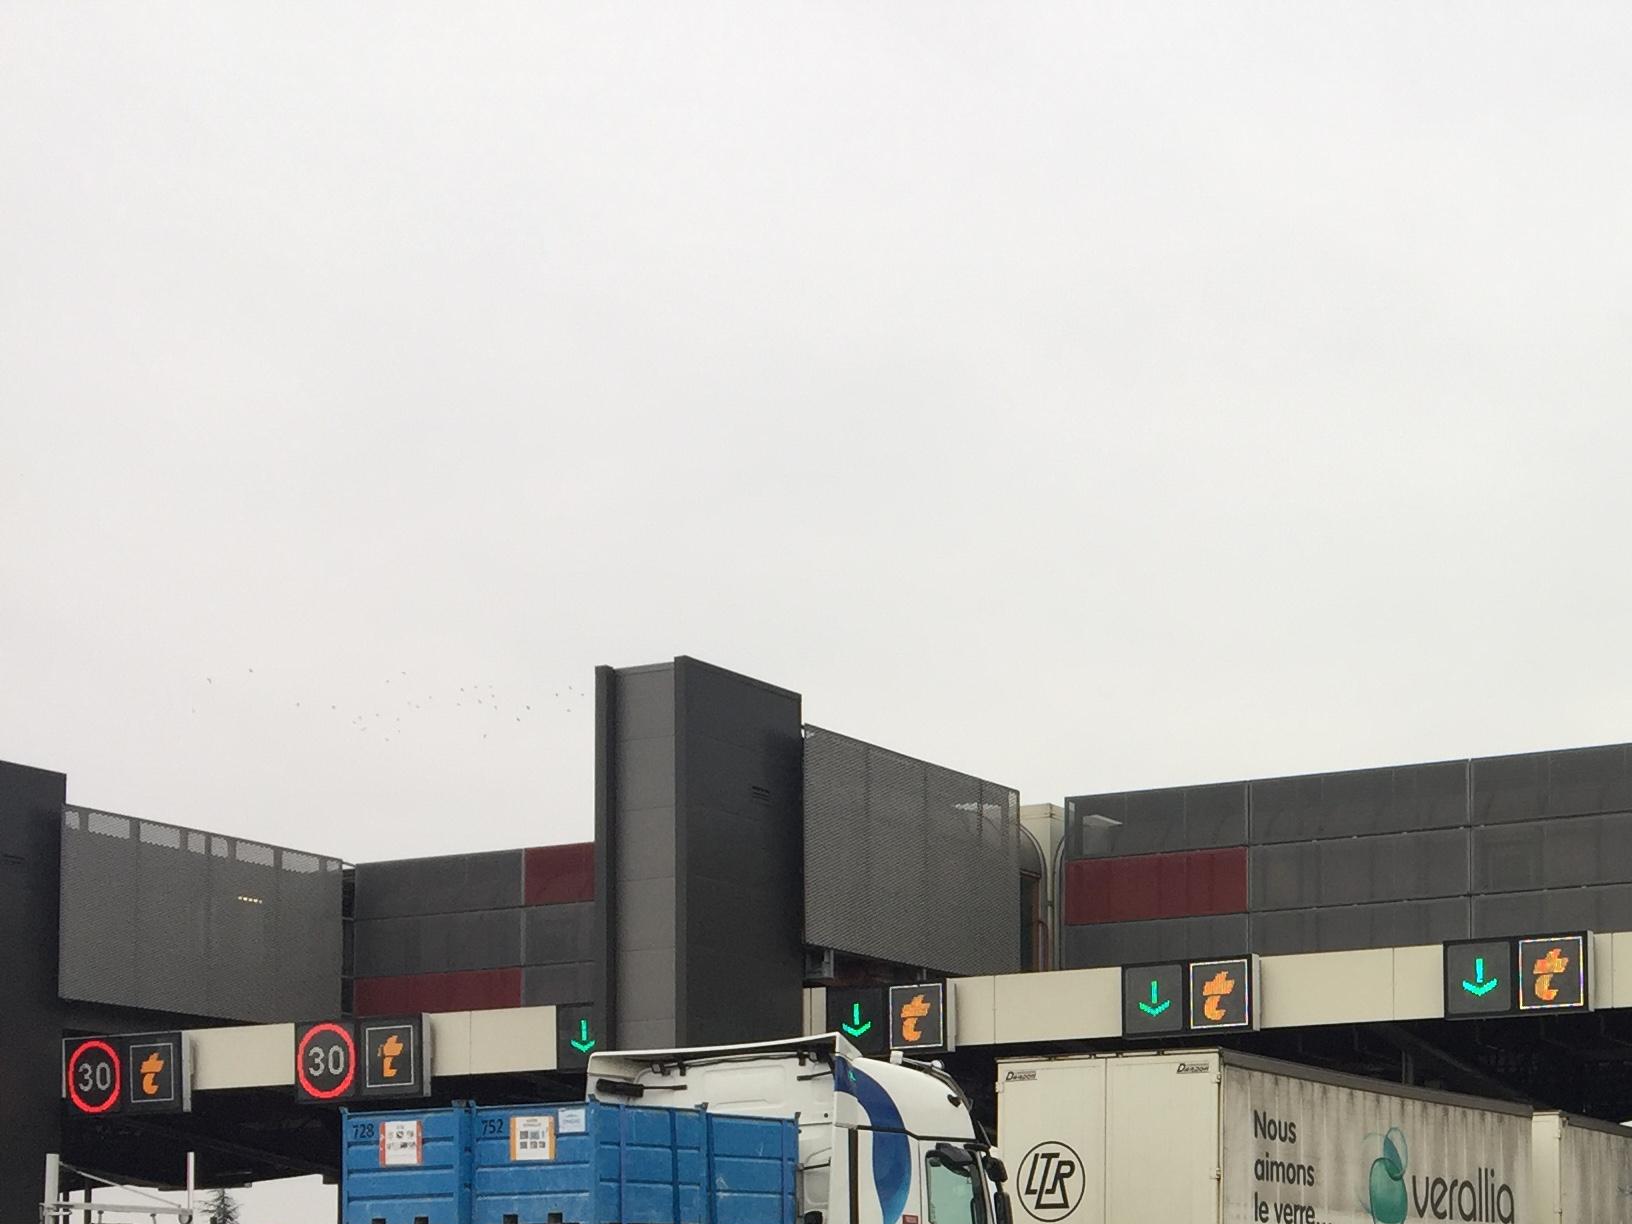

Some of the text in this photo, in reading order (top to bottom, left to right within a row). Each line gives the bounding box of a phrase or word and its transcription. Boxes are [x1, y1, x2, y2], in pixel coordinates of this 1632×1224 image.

[308, 1045, 346, 1077] 30
[78, 1062, 111, 1092] 30
[352, 1123, 375, 1139] 728
[481, 1119, 504, 1135] 752
[1253, 1110, 1297, 1144] Nous
[1254, 1152, 1315, 1187] aimons
[1254, 1192, 1269, 1223] le
[1412, 1167, 1515, 1224] verallia
